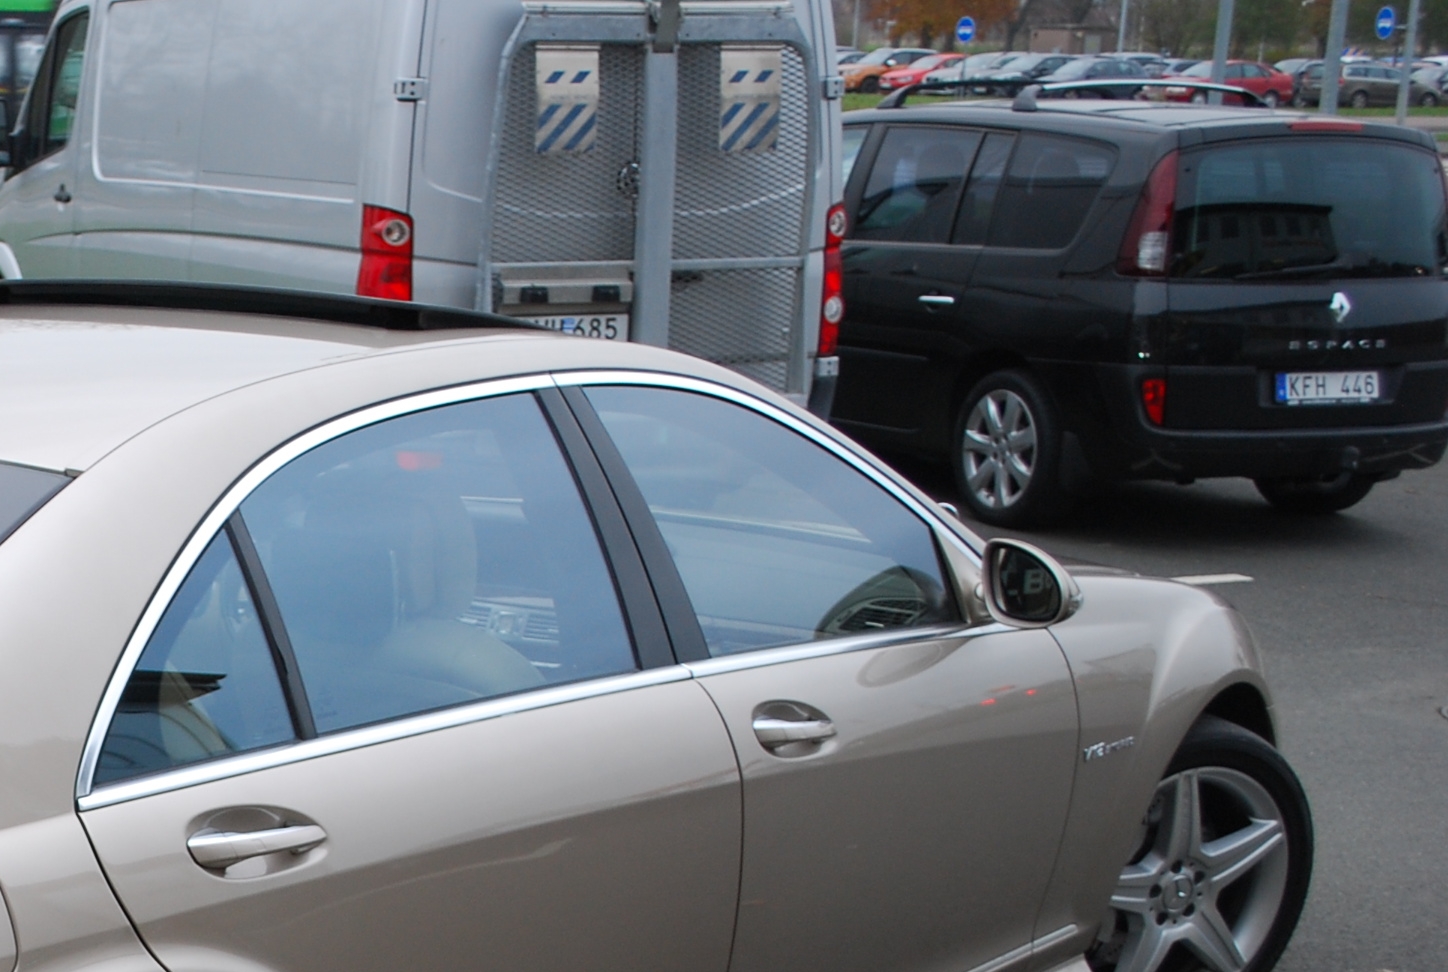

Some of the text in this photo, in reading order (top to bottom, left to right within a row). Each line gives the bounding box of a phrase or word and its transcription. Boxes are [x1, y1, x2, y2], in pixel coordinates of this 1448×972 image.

[573, 316, 617, 340] 685
[1288, 338, 1386, 350] ESPACE
[1288, 374, 1375, 396] KFH 446
